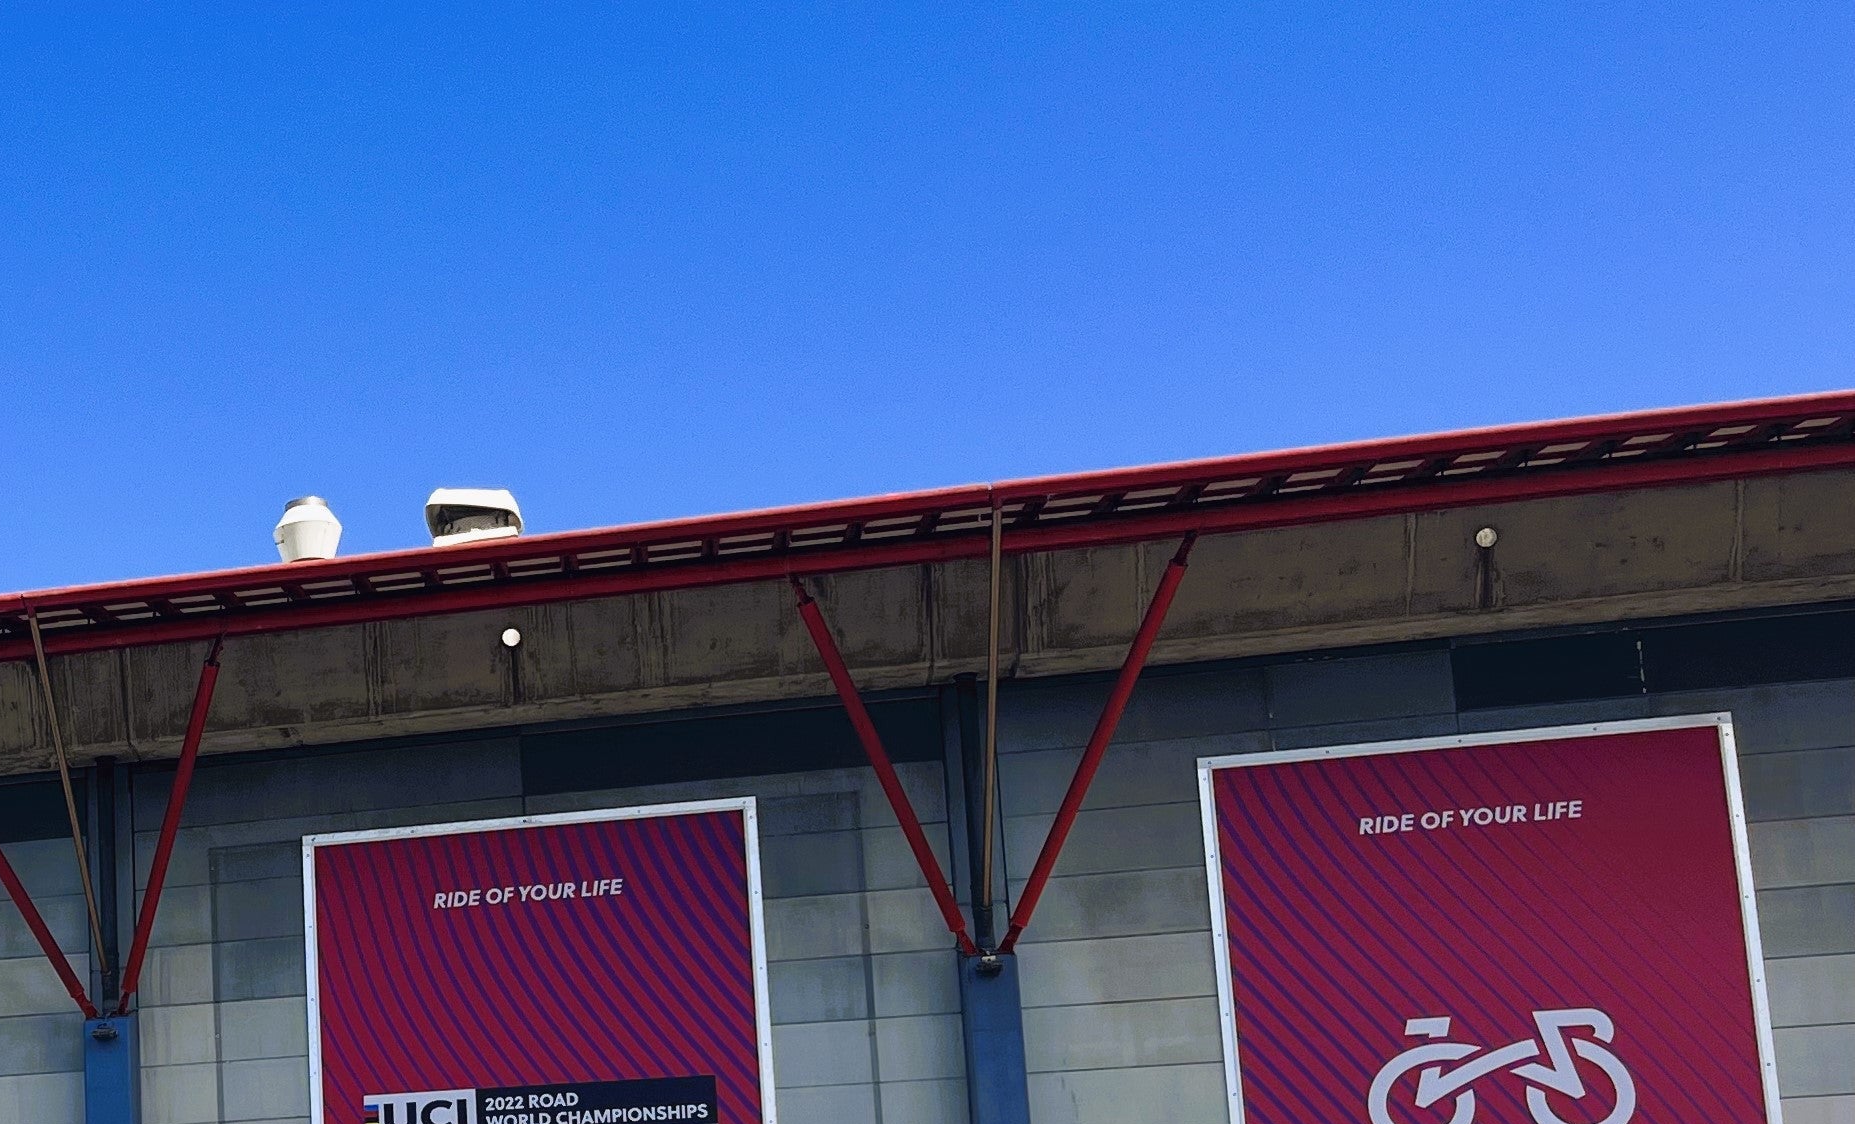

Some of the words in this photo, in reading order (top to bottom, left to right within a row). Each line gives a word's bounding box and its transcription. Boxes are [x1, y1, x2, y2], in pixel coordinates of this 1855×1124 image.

[1359, 814, 1414, 835] RIDE
[1420, 811, 1454, 830] OF
[1459, 806, 1527, 827] YOUR
[1534, 800, 1583, 821] LIFE
[433, 889, 482, 909] RIDE
[485, 887, 514, 904] OF
[518, 882, 576, 902] YOUR
[581, 878, 623, 898] LIFE
[485, 1096, 525, 1111] 2022
[528, 1092, 579, 1109] ROAD
